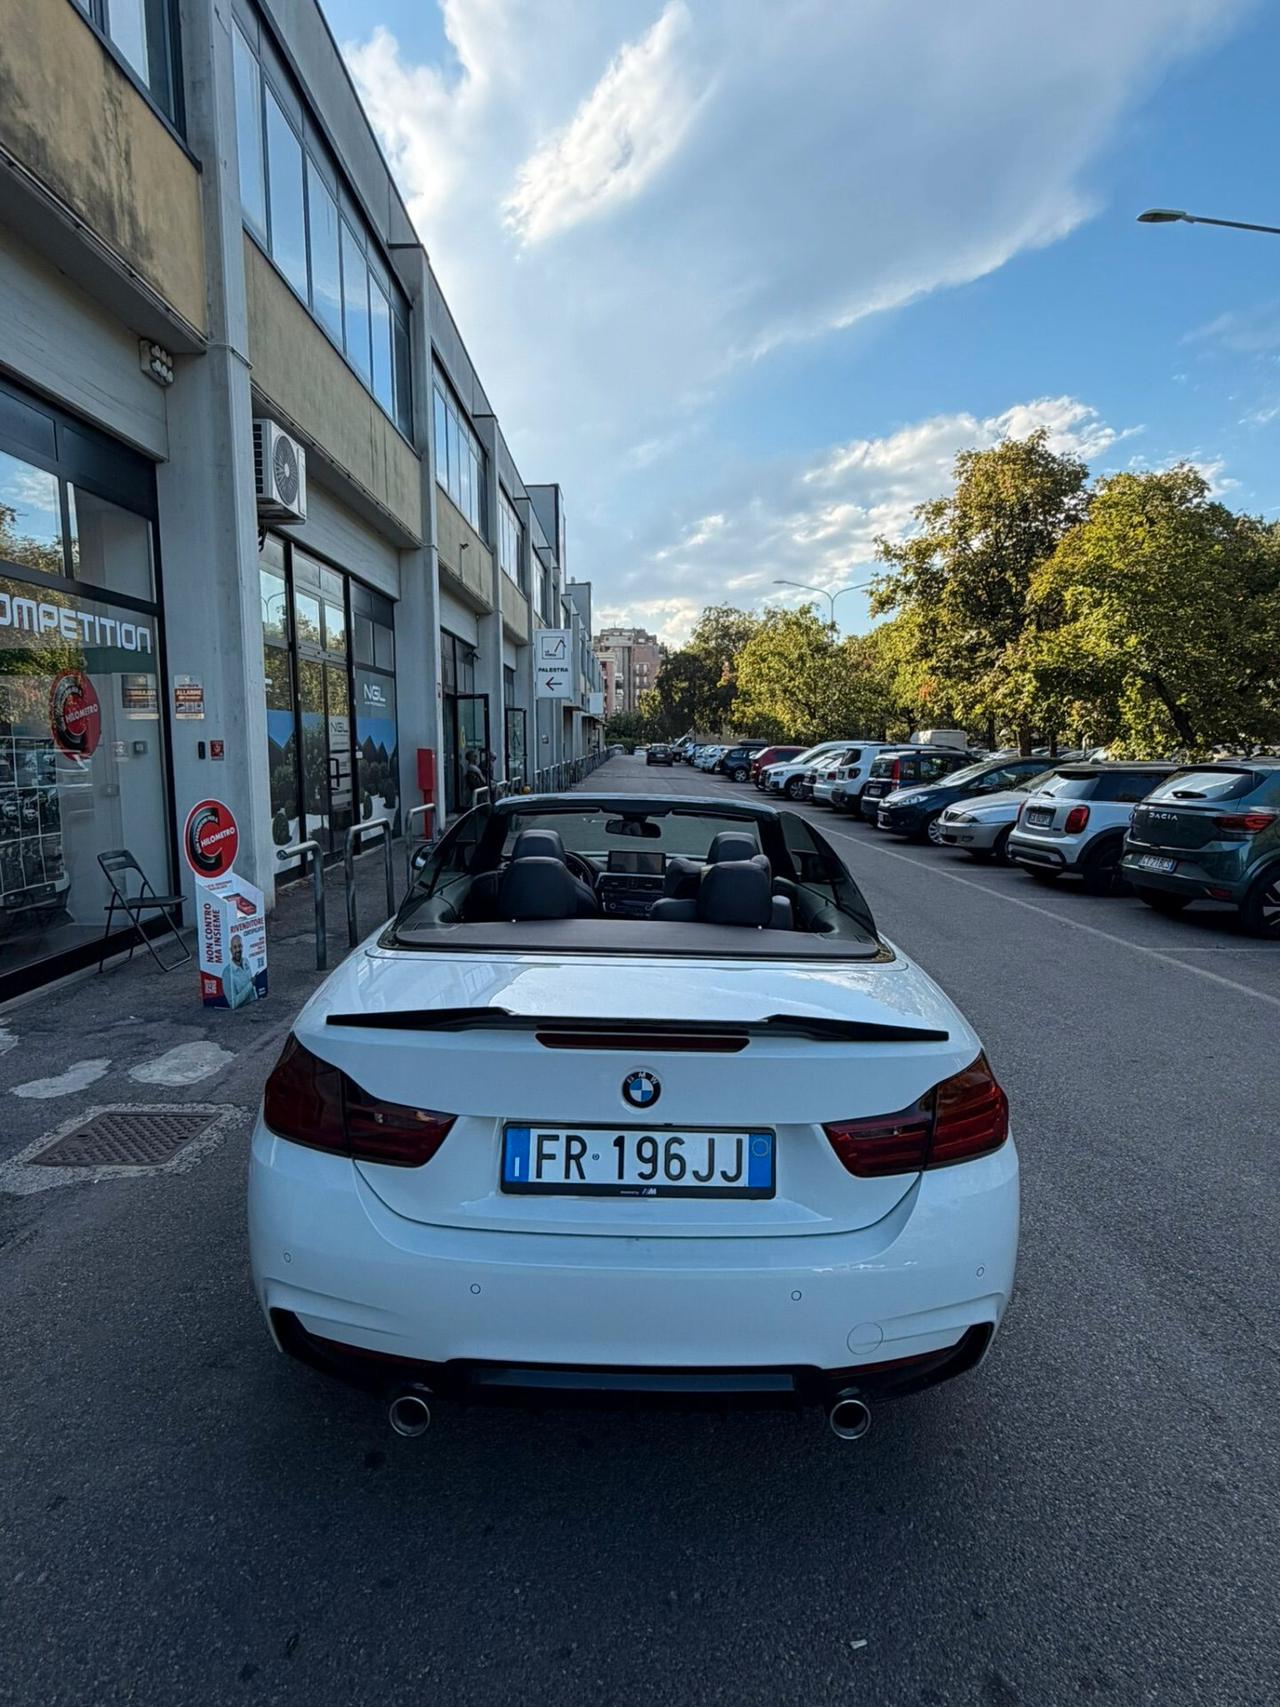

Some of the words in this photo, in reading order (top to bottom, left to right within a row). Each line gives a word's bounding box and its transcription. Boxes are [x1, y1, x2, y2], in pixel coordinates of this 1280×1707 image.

[364, 683, 386, 702] NGL
[330, 722, 349, 734] NGL
[1148, 812, 1179, 821] DACIA
[203, 903, 214, 941] CONTRO
[212, 909, 222, 947] INSIEME
[230, 917, 265, 934] RIVENDITORE
[205, 943, 215, 963] NON
[214, 950, 223, 964] MA
[626, 1071, 658, 1085] BMW
[535, 1133, 588, 1180] FR
[613, 1135, 743, 1182] 196JJ
